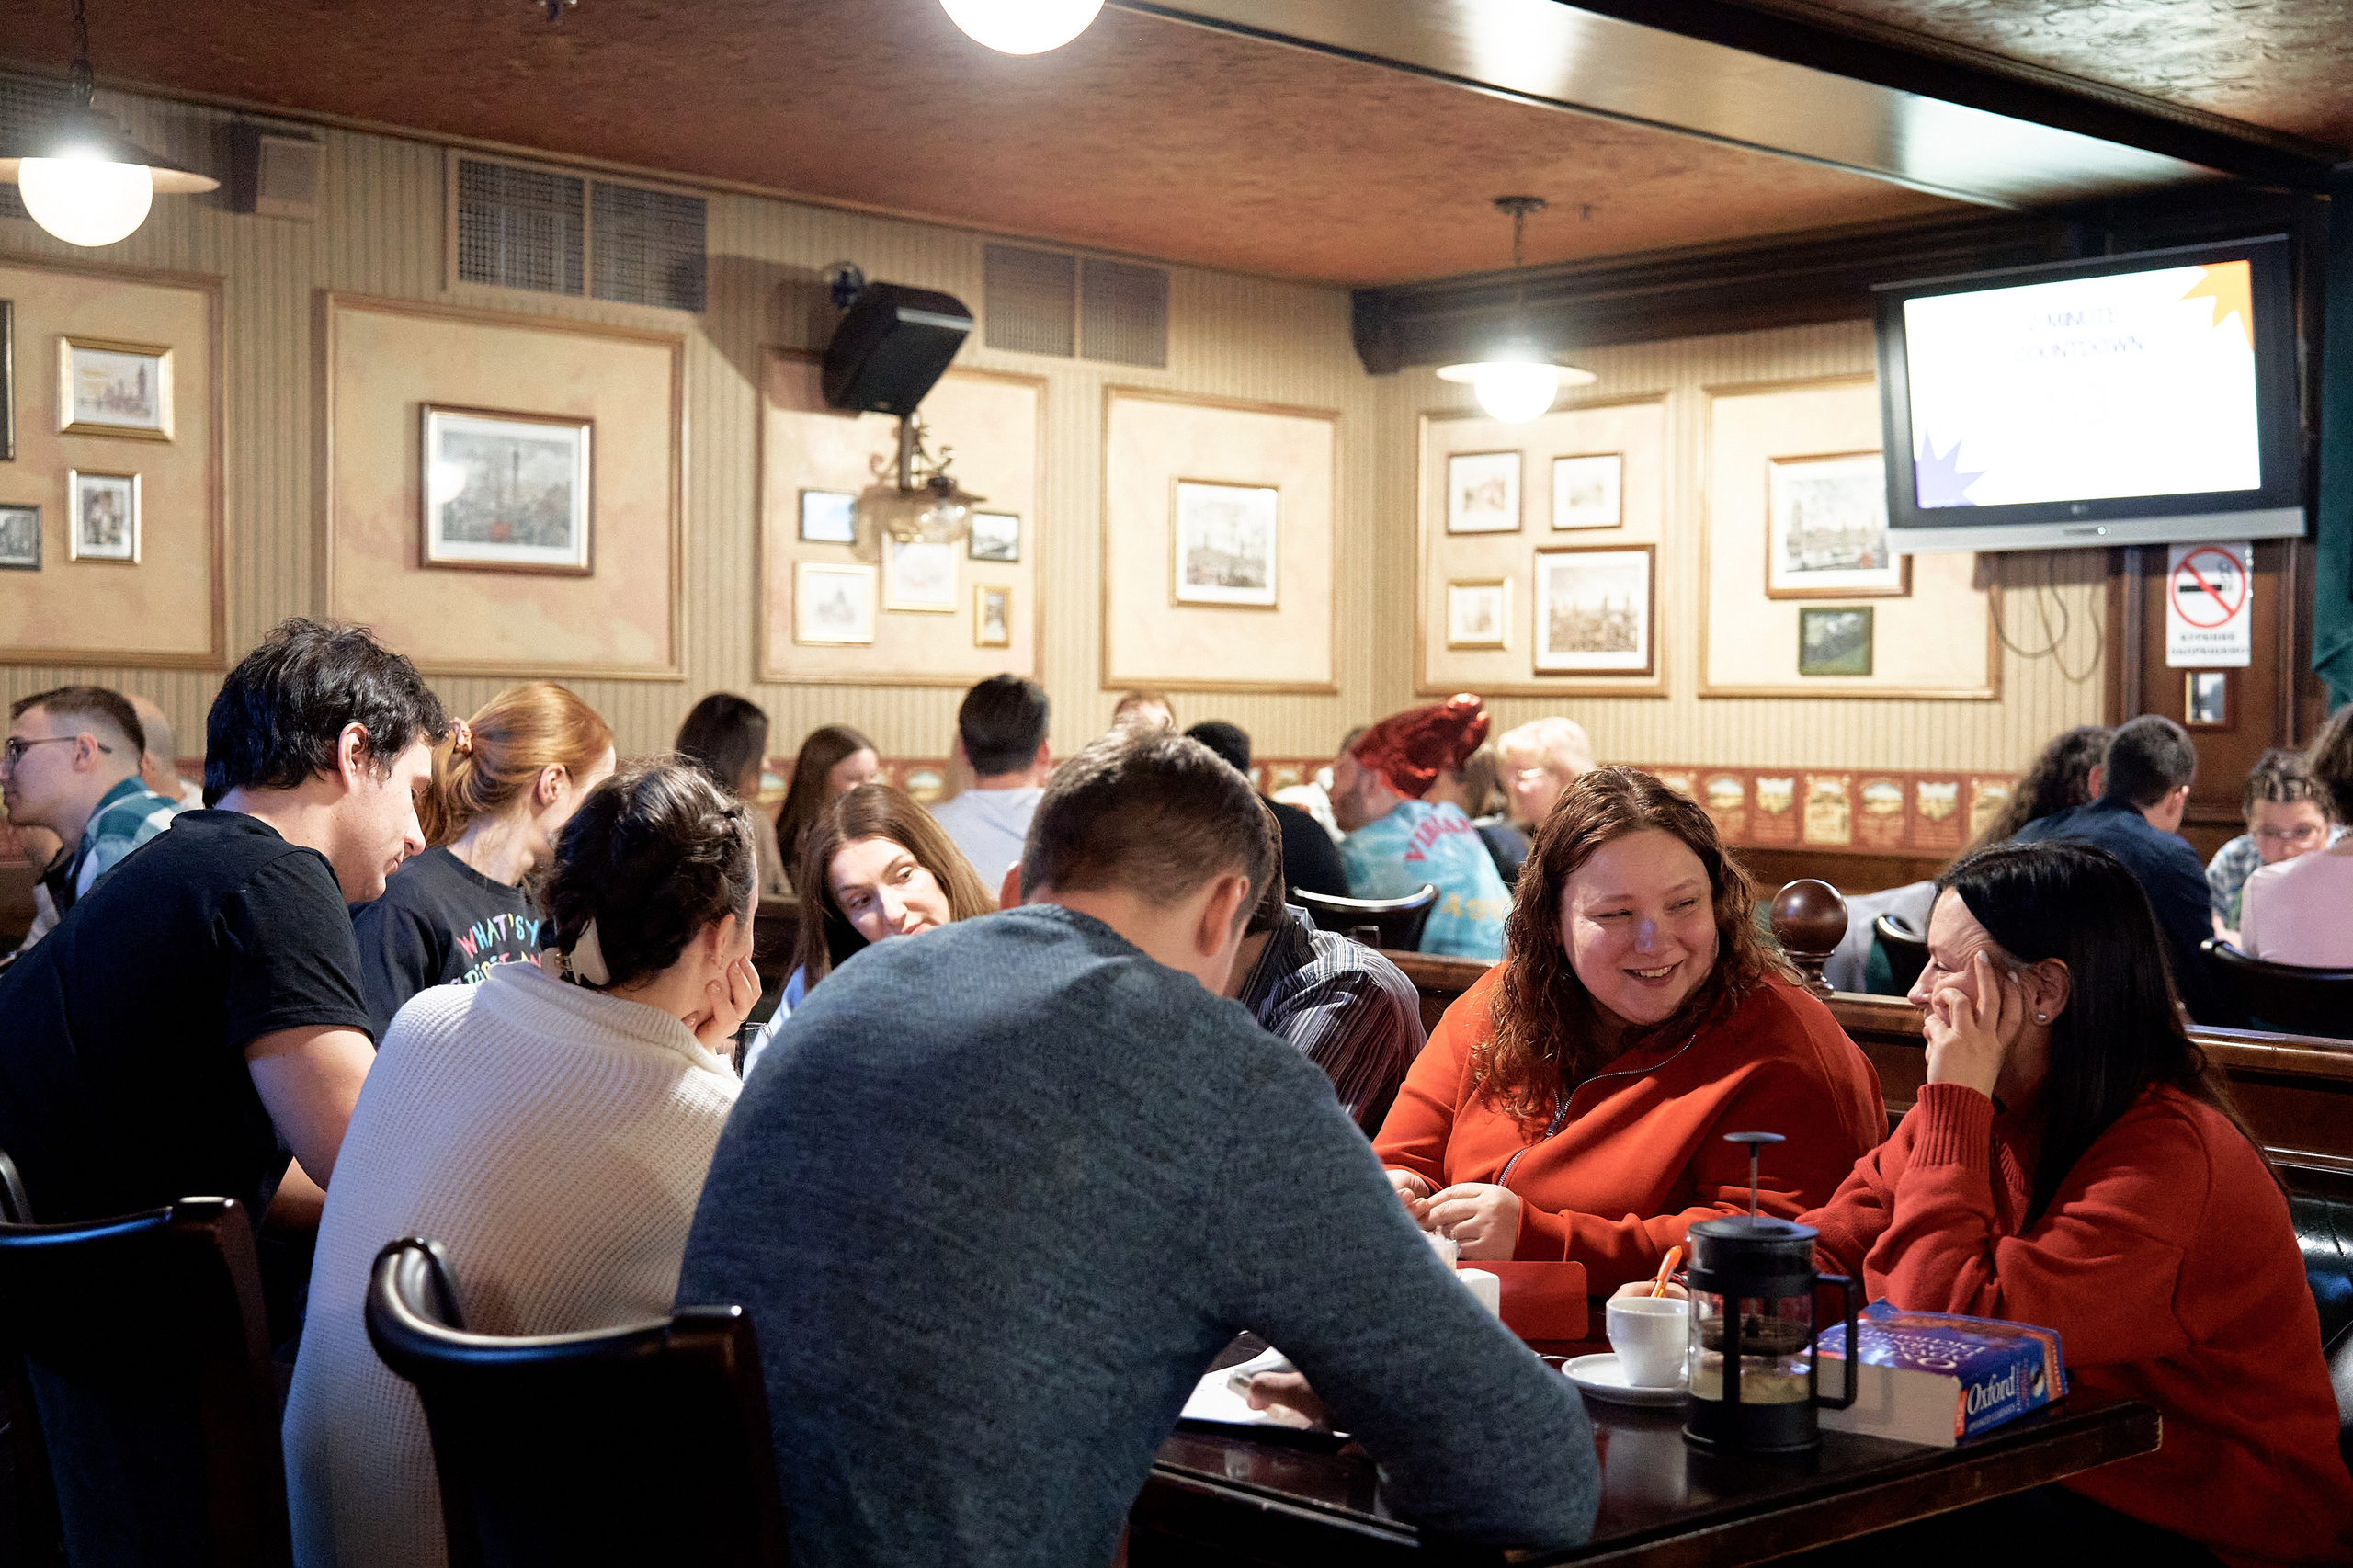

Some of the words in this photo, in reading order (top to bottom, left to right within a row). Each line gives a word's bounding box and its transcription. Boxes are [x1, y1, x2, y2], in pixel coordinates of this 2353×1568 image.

[2046, 306, 2120, 328] MINUTE
[2014, 335, 2144, 363] COUNTDOWN
[456, 913, 525, 960] WHAT'S
[1967, 1365, 2016, 1415] Oxford
